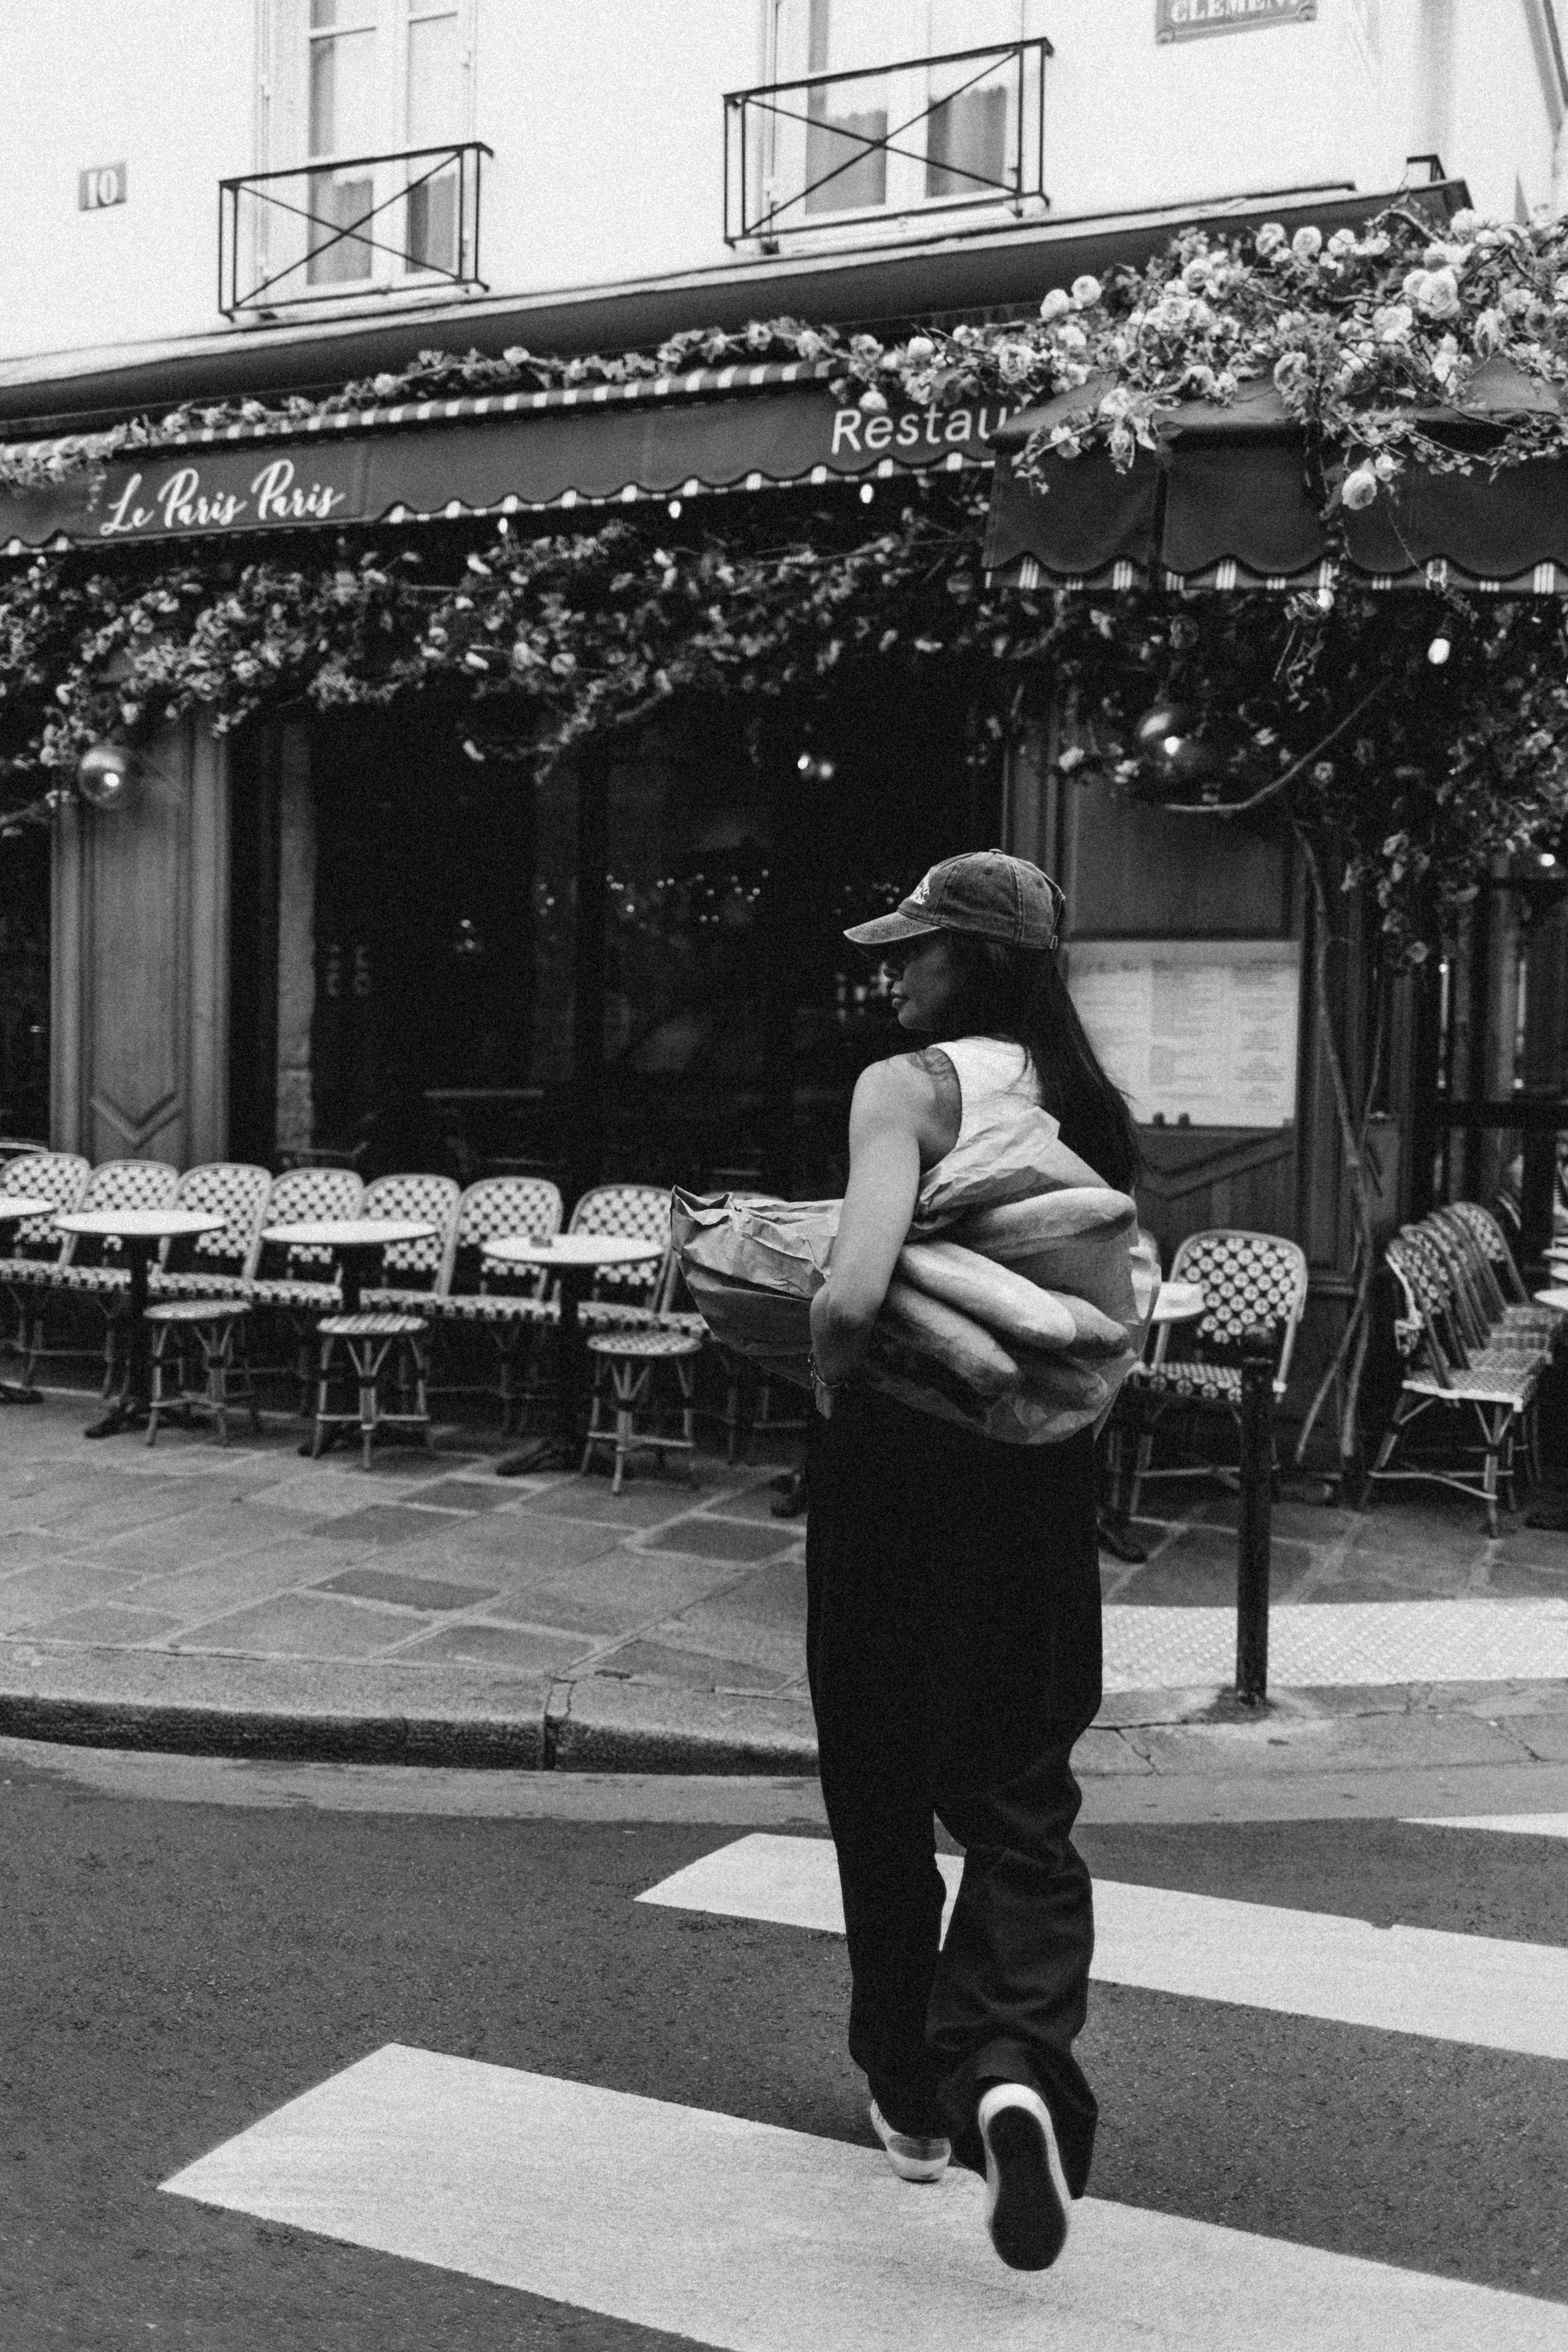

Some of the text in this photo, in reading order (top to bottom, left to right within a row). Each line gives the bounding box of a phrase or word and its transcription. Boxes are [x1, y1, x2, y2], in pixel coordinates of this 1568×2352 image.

[88, 170, 118, 207] 10
[100, 459, 346, 536] Le Paris Paris
